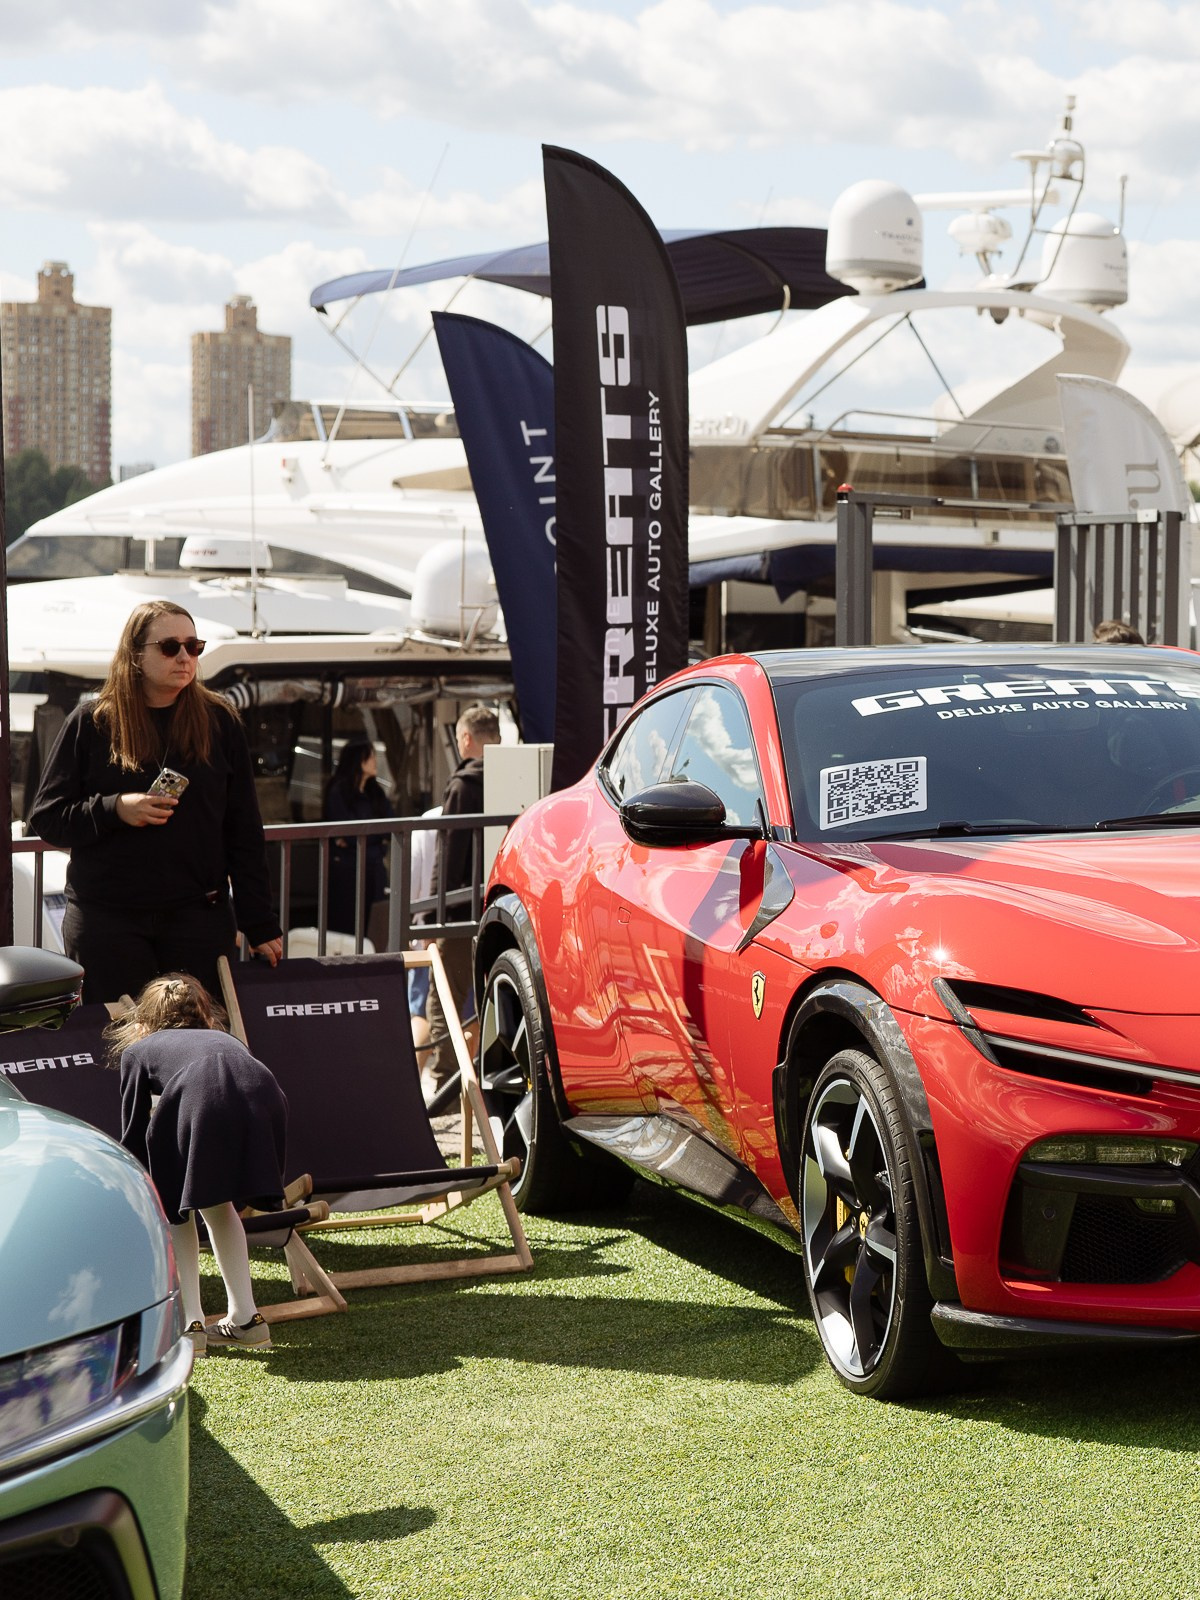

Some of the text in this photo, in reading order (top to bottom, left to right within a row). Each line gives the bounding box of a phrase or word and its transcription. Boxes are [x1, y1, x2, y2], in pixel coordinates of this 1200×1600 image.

[520, 420, 557, 575] INT
[645, 390, 662, 694] ELUXE AUTO GALLERY
[936, 700, 1188, 720] DELUXE AUTO GALLERY
[266, 999, 380, 1017] GREATS
[0, 1052, 94, 1075] REATS
